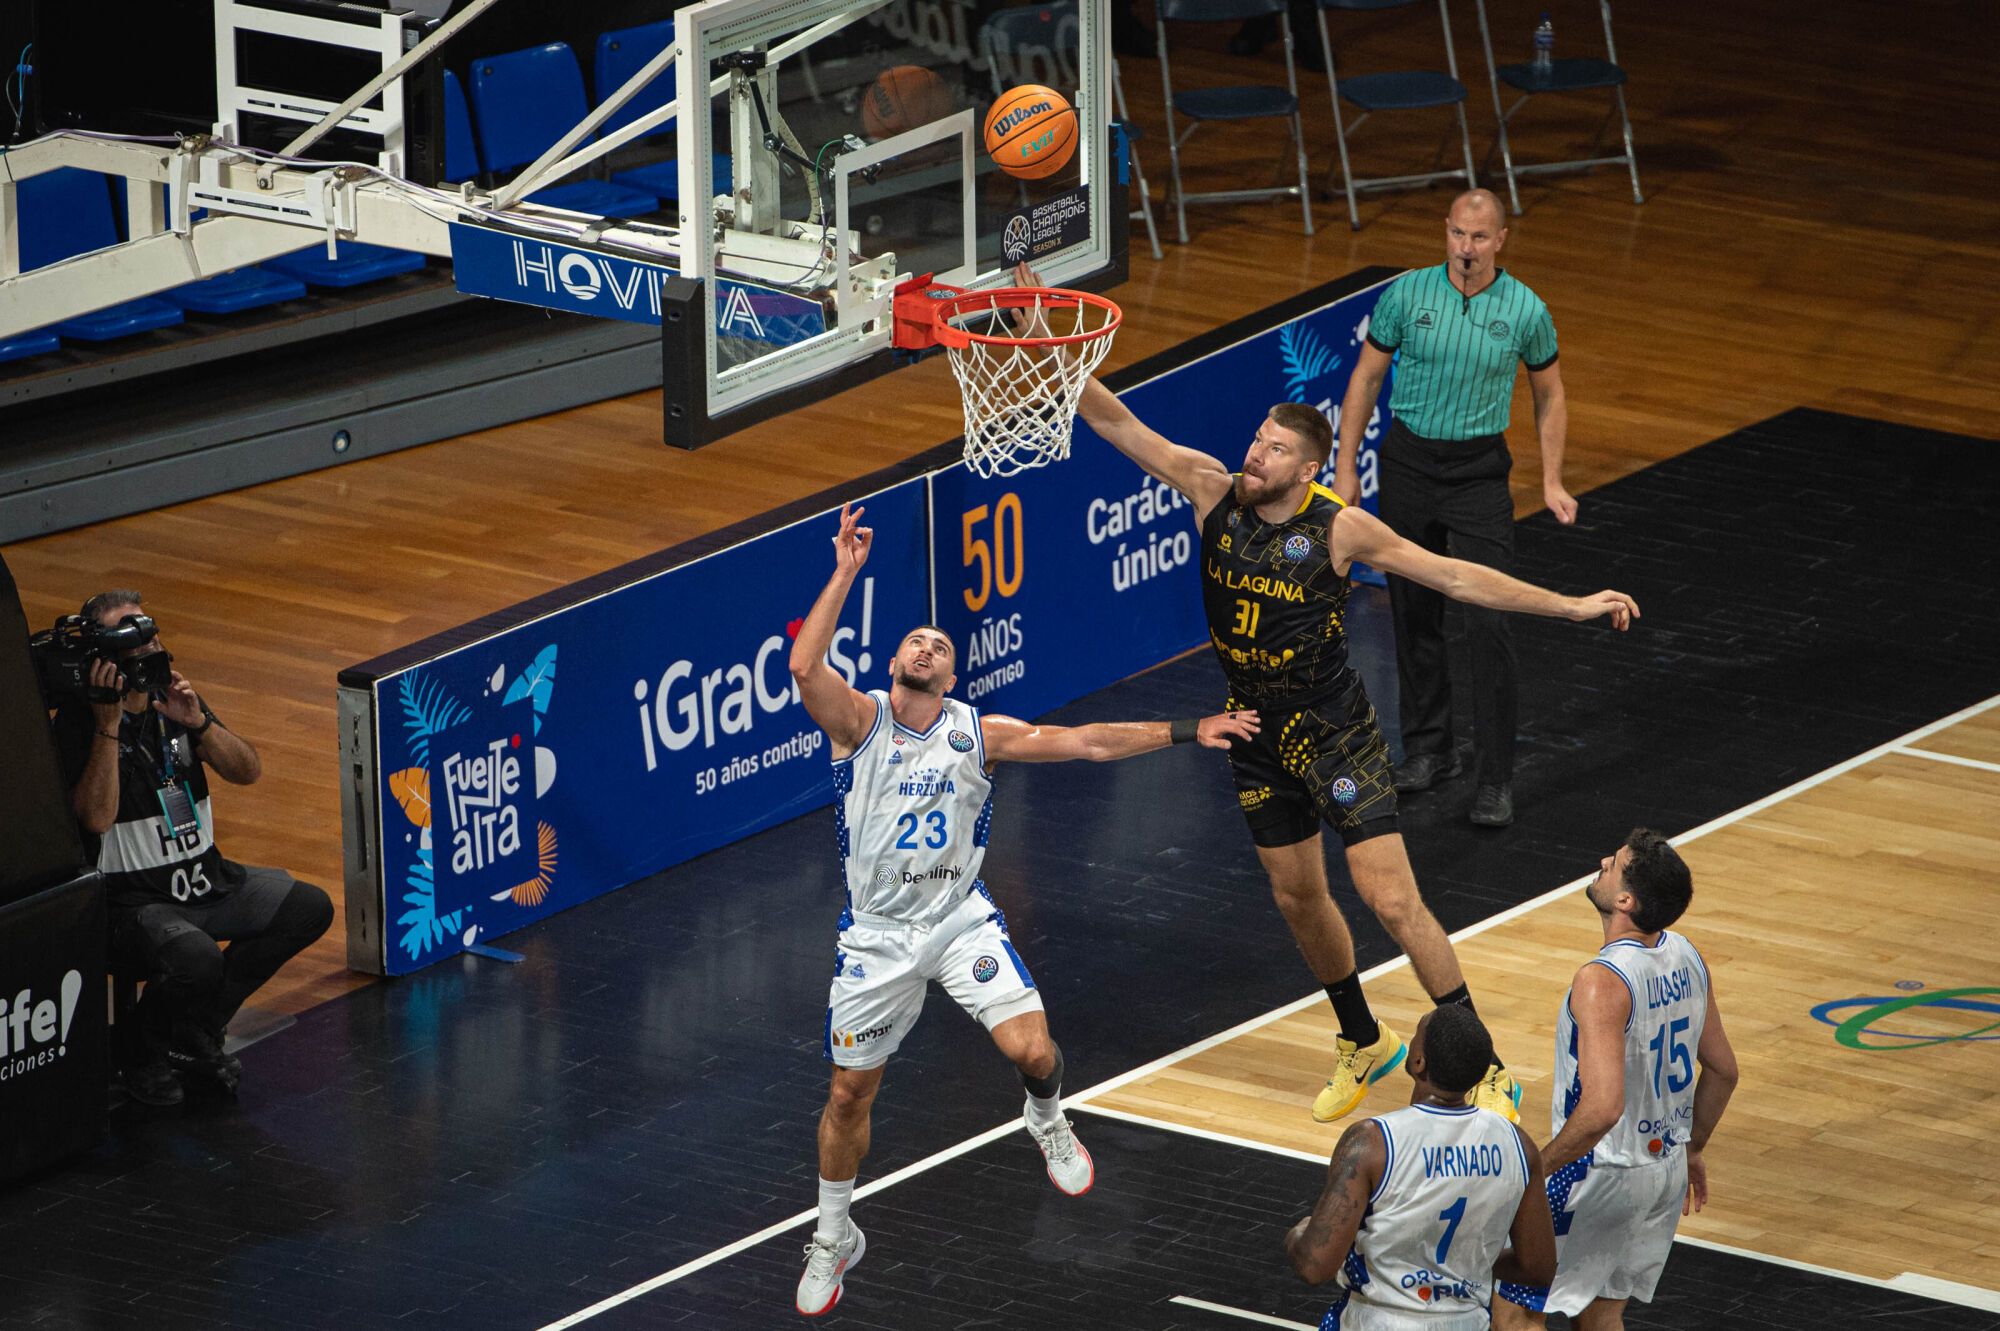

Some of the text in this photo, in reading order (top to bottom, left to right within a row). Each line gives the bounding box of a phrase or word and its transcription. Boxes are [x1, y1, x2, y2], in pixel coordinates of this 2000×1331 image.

[994, 101, 1053, 137] Wilson
[1032, 193, 1080, 218] BASKETBALL
[1032, 201, 1086, 230] CHAMPIONS
[1032, 222, 1062, 242] LEAGUE
[513, 240, 765, 336] HOVIA
[1087, 475, 1191, 544] Caráct
[962, 492, 1024, 612] 50
[1113, 532, 1190, 592] único
[1208, 557, 1305, 603] LA LAGUNA
[1232, 599, 1260, 638] 31
[967, 612, 1023, 672] AÑOS
[968, 659, 1024, 700] CONTIGO
[696, 730, 822, 795] 50 años contigo
[899, 780, 955, 796] HERZLIYA
[896, 810, 947, 849] 23
[171, 862, 212, 901] 05
[902, 865, 962, 885] penlink
[1650, 1016, 1693, 1100] 15
[1422, 1144, 1502, 1178] VARNADO
[1436, 1197, 1467, 1264] 1
